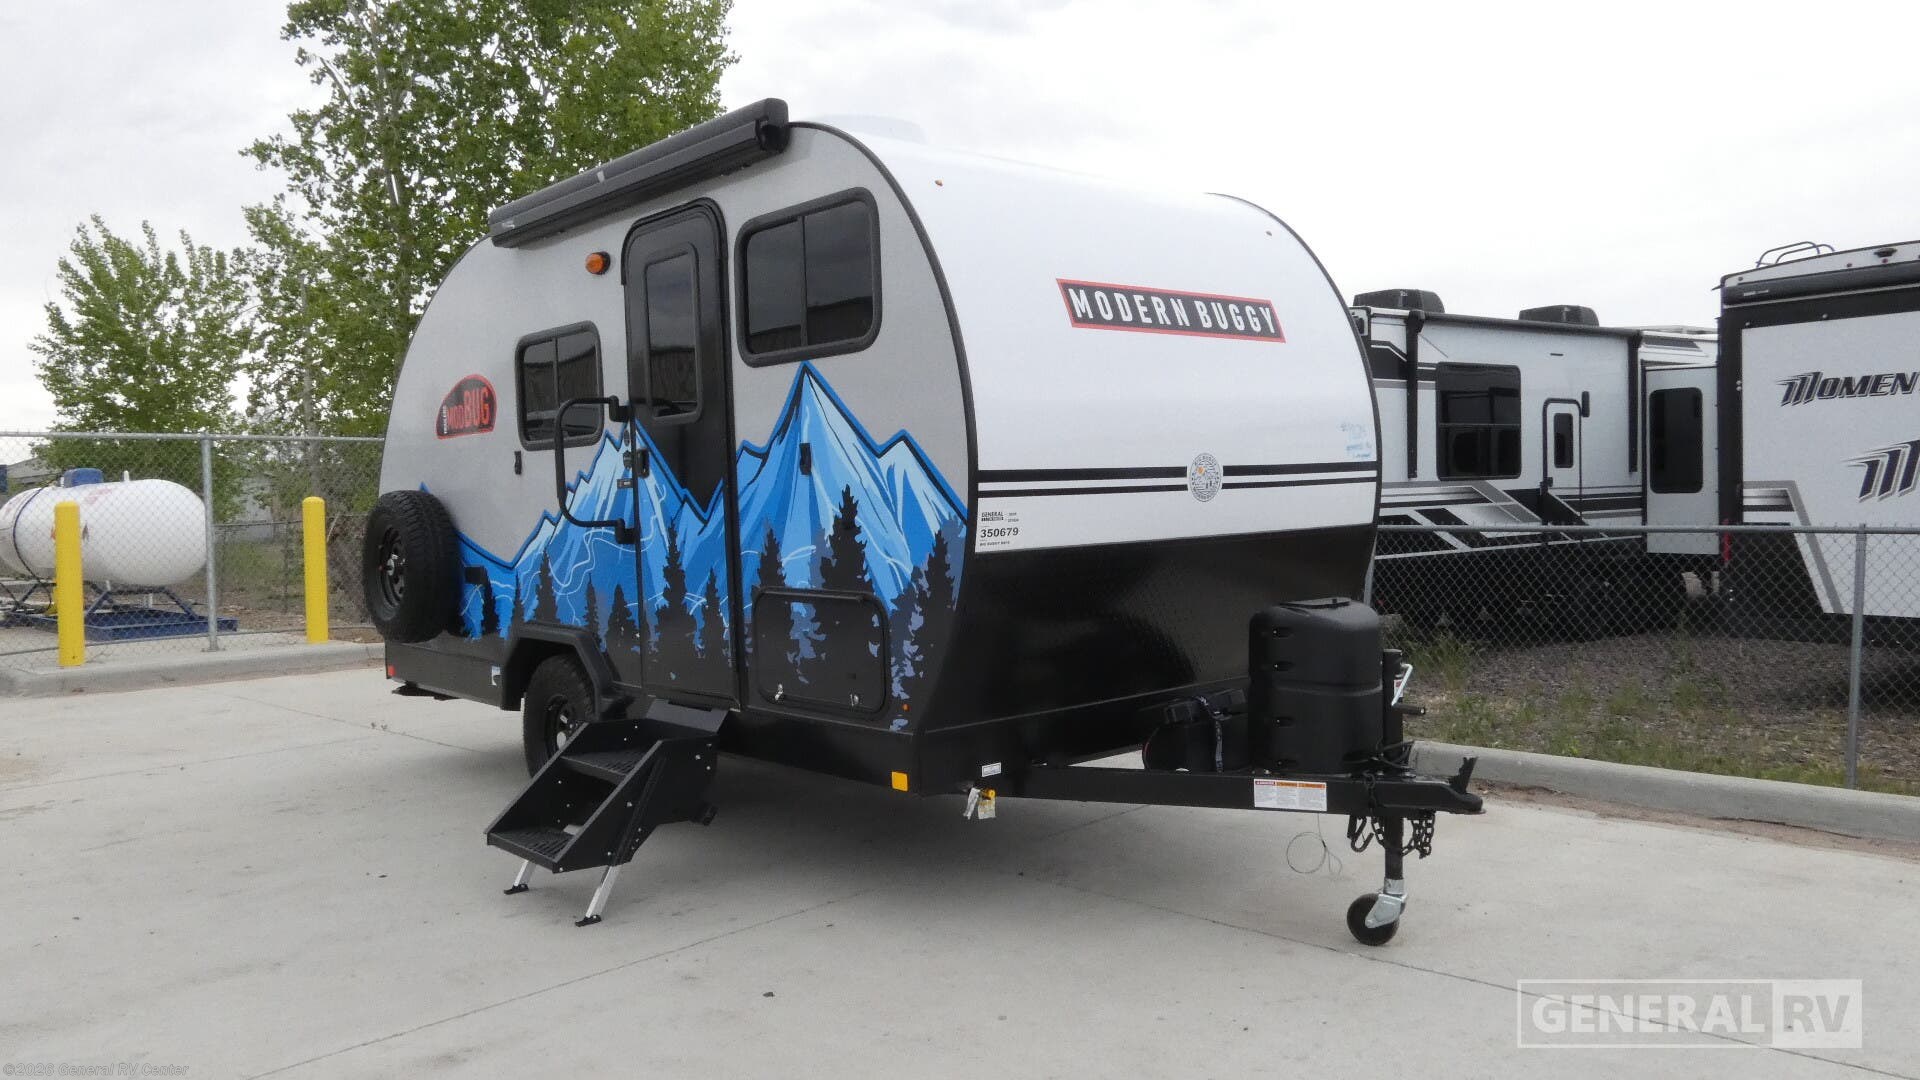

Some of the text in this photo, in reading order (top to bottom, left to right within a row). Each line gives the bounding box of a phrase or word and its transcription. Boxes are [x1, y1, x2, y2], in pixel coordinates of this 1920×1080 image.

[1068, 287, 1276, 334] MODERN BUGGY
[1776, 371, 1920, 407] MOMEN
[980, 527, 1019, 538] 350679
